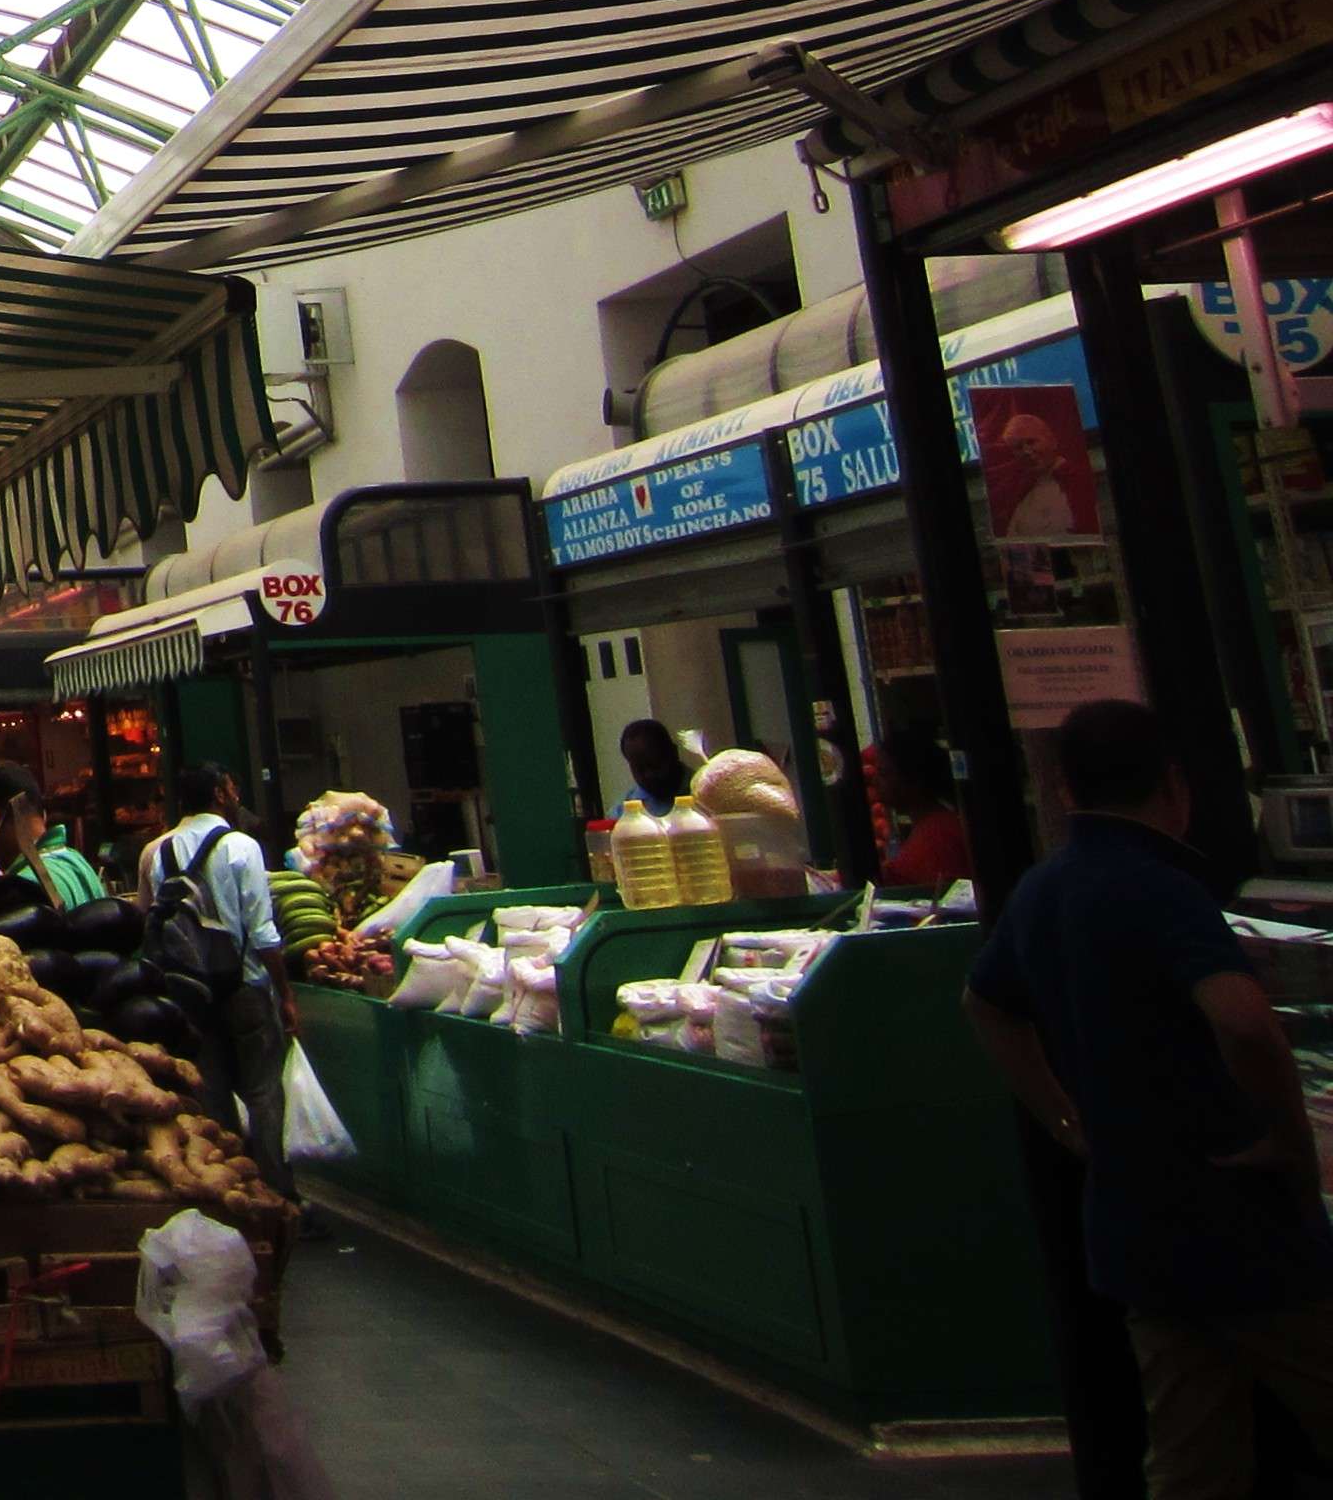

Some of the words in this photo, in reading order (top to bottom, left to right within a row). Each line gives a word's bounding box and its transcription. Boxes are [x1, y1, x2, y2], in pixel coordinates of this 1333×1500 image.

[786, 417, 841, 464] BOX
[681, 481, 705, 499] OF
[797, 466, 827, 505] 75
[562, 486, 619, 517] ARRIBA
[672, 494, 727, 519] ROME
[563, 508, 630, 541] ALIANZA
[652, 503, 771, 542] CHINCHANO
[567, 535, 615, 562] VAMOS
[263, 575, 322, 598] BOX
[276, 601, 313, 623] 76
